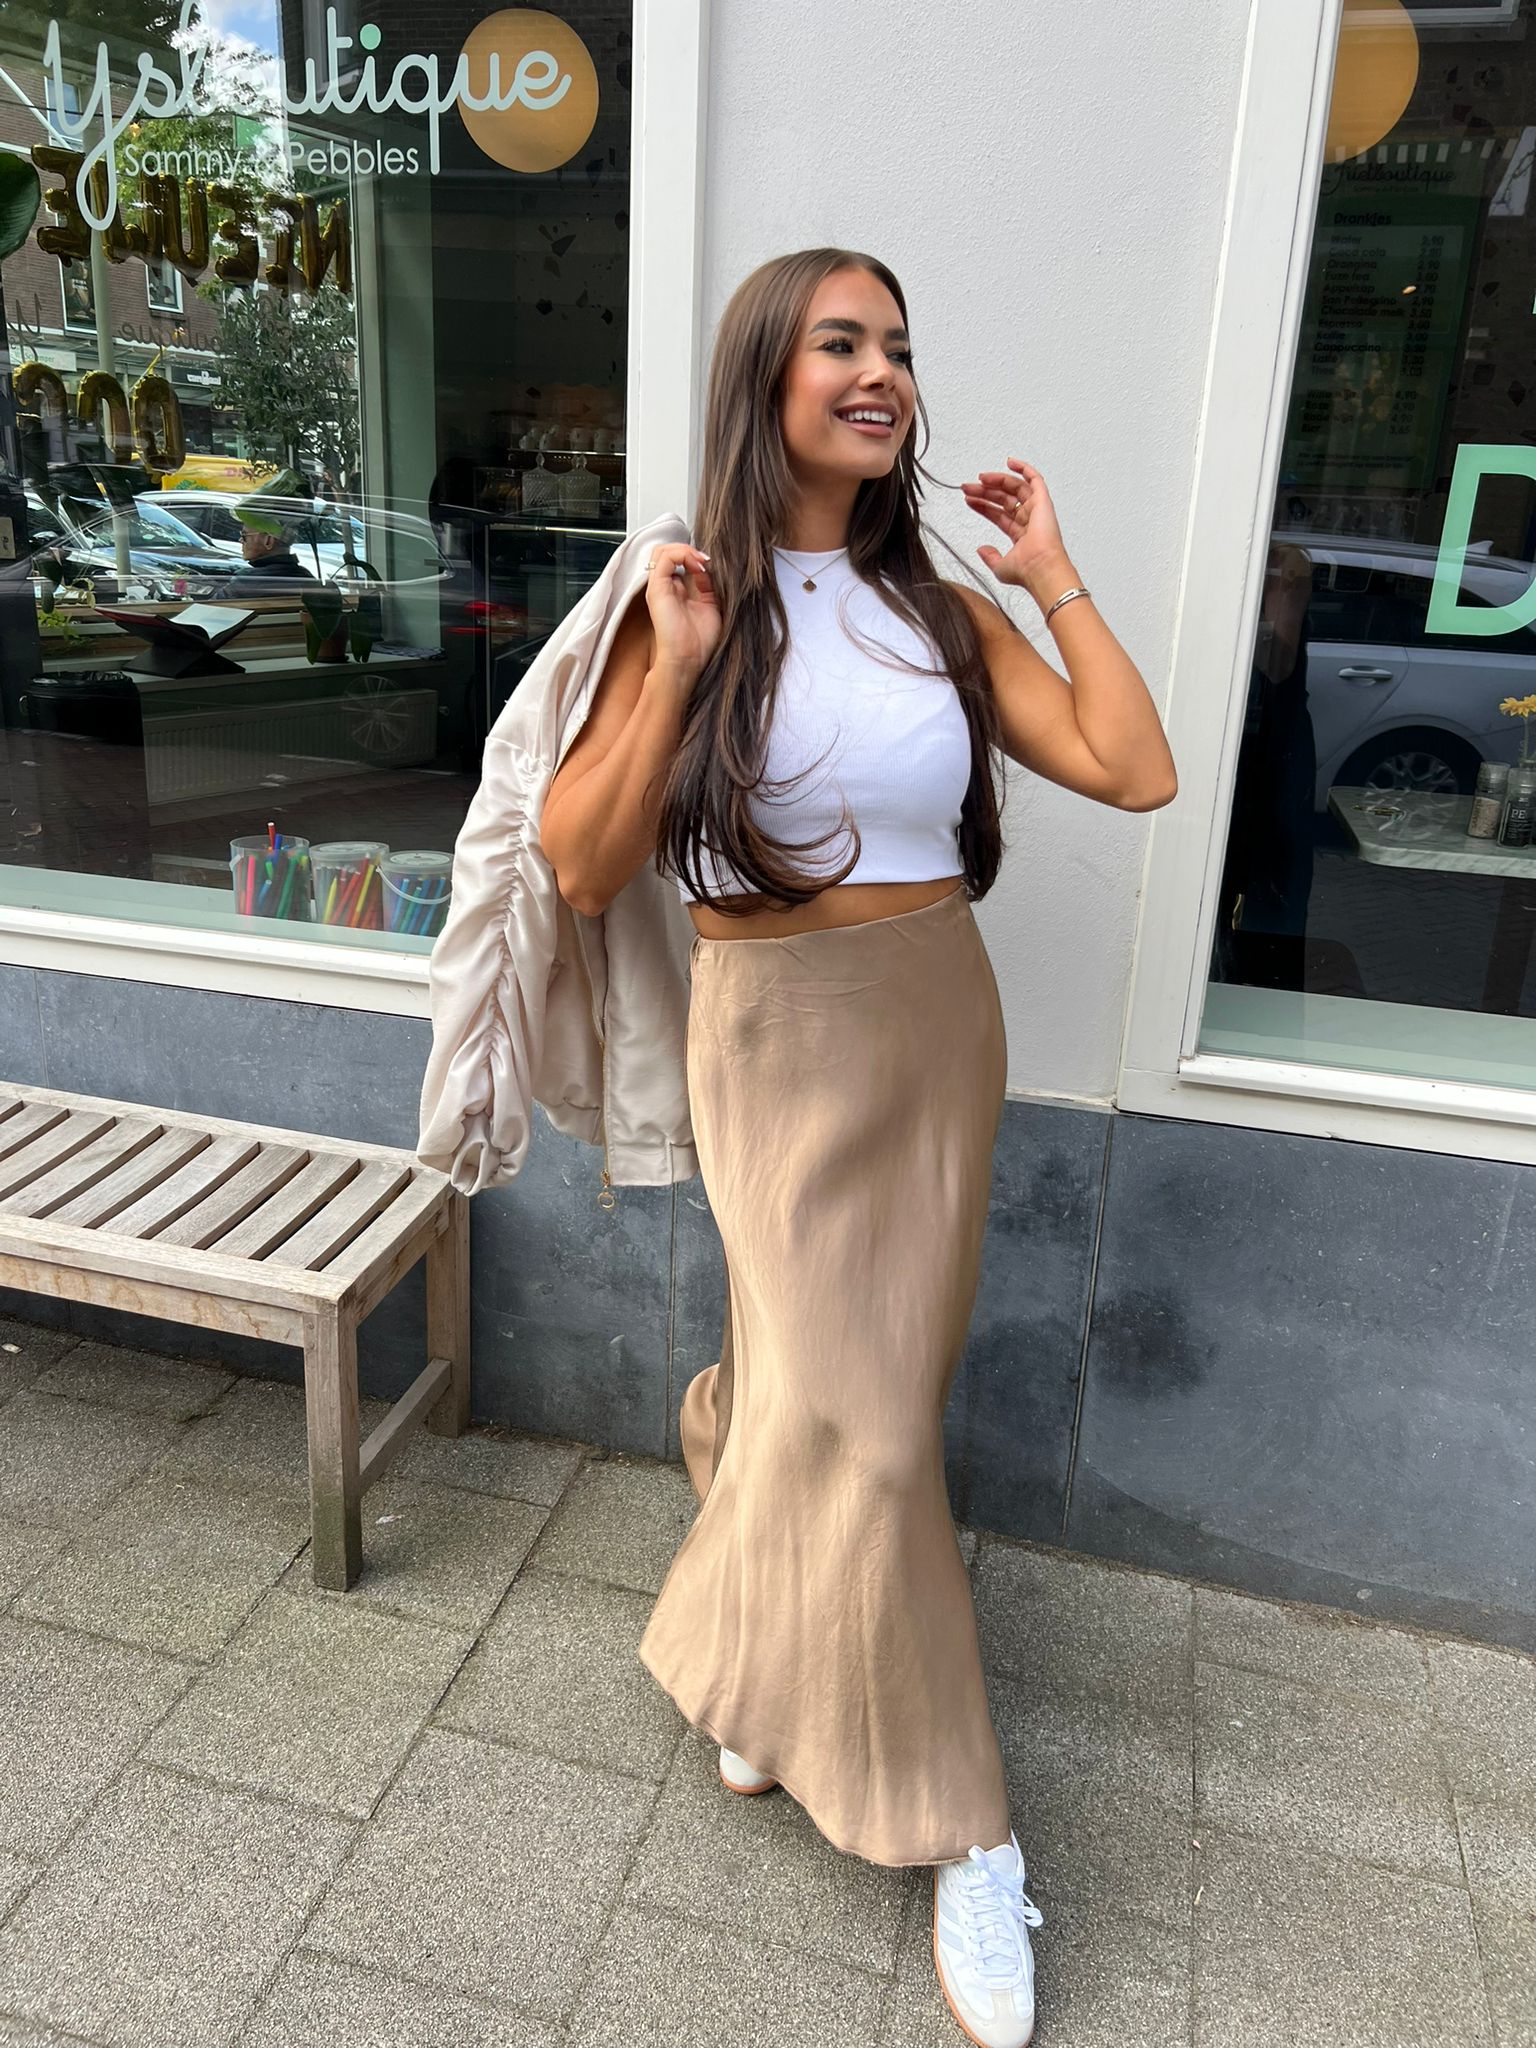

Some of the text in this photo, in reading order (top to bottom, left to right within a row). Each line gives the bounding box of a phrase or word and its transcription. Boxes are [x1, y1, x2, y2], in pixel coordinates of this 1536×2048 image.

[124, 143, 243, 184] Sammy
[288, 139, 419, 175] Pebbles
[1334, 211, 1392, 227] Drankjes
[1314, 342, 1382, 353] Cappuccino
[1425, 443, 1536, 635] D
